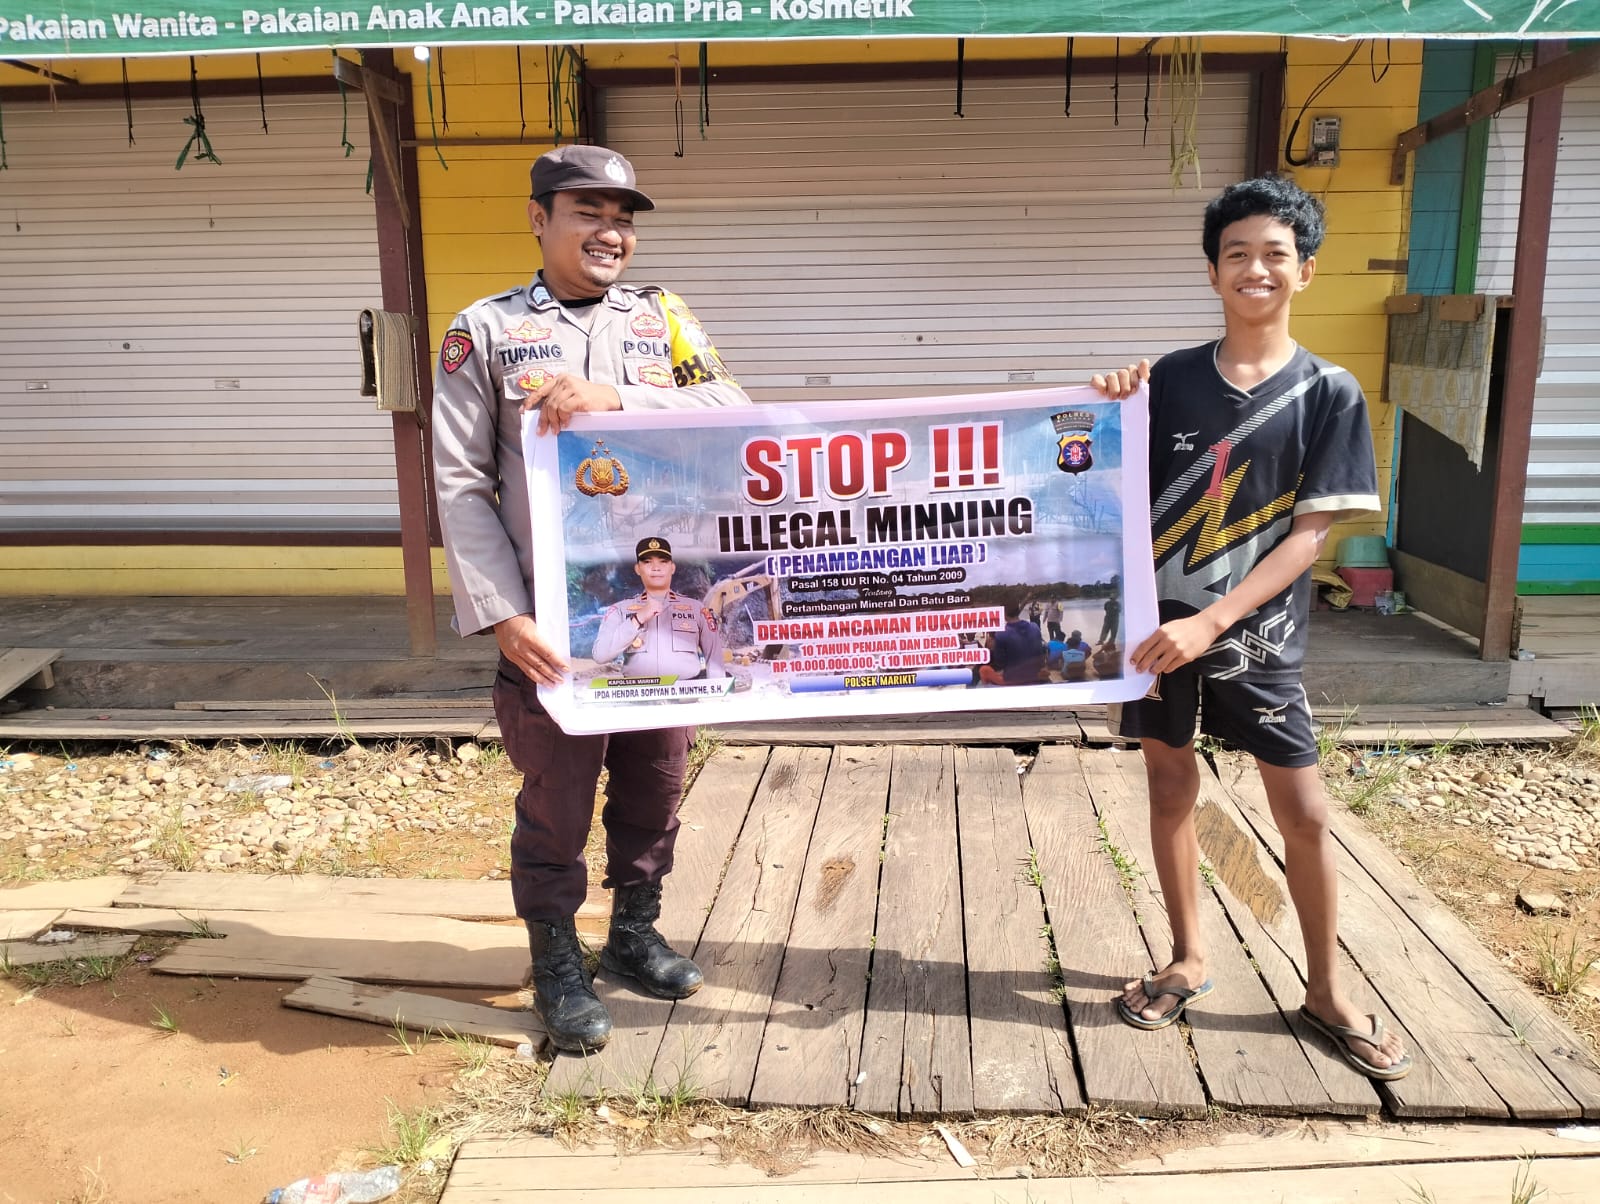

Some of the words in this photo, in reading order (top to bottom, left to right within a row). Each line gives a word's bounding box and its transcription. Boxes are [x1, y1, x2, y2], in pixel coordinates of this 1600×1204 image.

[0, 14, 107, 41] Pakaian
[112, 11, 217, 38] Wanita
[242, 7, 359, 35] Pakaian
[367, 2, 445, 31] Anak
[450, 0, 530, 28] Anak
[554, 0, 674, 25] Pakaian
[684, 0, 743, 22] Pria
[770, 0, 915, 20] Kosmetik
[499, 344, 562, 366] TUPANG
[743, 431, 908, 502] STOP
[932, 424, 1000, 488] !!!
[718, 509, 857, 552] ILLEGAL
[866, 497, 1033, 543] MINNING
[779, 547, 926, 575] PENAMBANGAN
[931, 544, 974, 566] LIAR
[791, 580, 819, 589] Pasal
[821, 578, 839, 588] 158
[841, 576, 856, 586] UU
[859, 576, 870, 585] RI
[872, 576, 889, 585] No.
[891, 574, 904, 583] 04
[906, 573, 937, 582] Tahun
[939, 571, 963, 580] 2009
[785, 602, 857, 613] Pertambangan
[860, 598, 896, 609] Mineral
[899, 598, 918, 606] Dan
[921, 596, 944, 605] Batu
[947, 595, 970, 603] Bara
[757, 622, 824, 640] DENGAN
[828, 616, 911, 638] ANCAMAN
[915, 611, 1001, 632] HUKUMAN
[801, 645, 814, 656] 10
[816, 643, 851, 655] TAHUN
[853, 640, 897, 653] PENJARA
[899, 639, 920, 650] DAN
[923, 636, 958, 649] DENDA
[773, 661, 788, 673] RP.
[888, 654, 900, 667] 10
[903, 653, 940, 666] MILYAR
[942, 650, 981, 664] RUPIAH
[594, 690, 610, 699] IPDA
[611, 689, 639, 699] HENDRA
[640, 687, 669, 697] SOPIYAN
[710, 685, 724, 694] S.H.
[844, 676, 878, 688] POLSEK
[879, 674, 917, 686] MARIKIT
